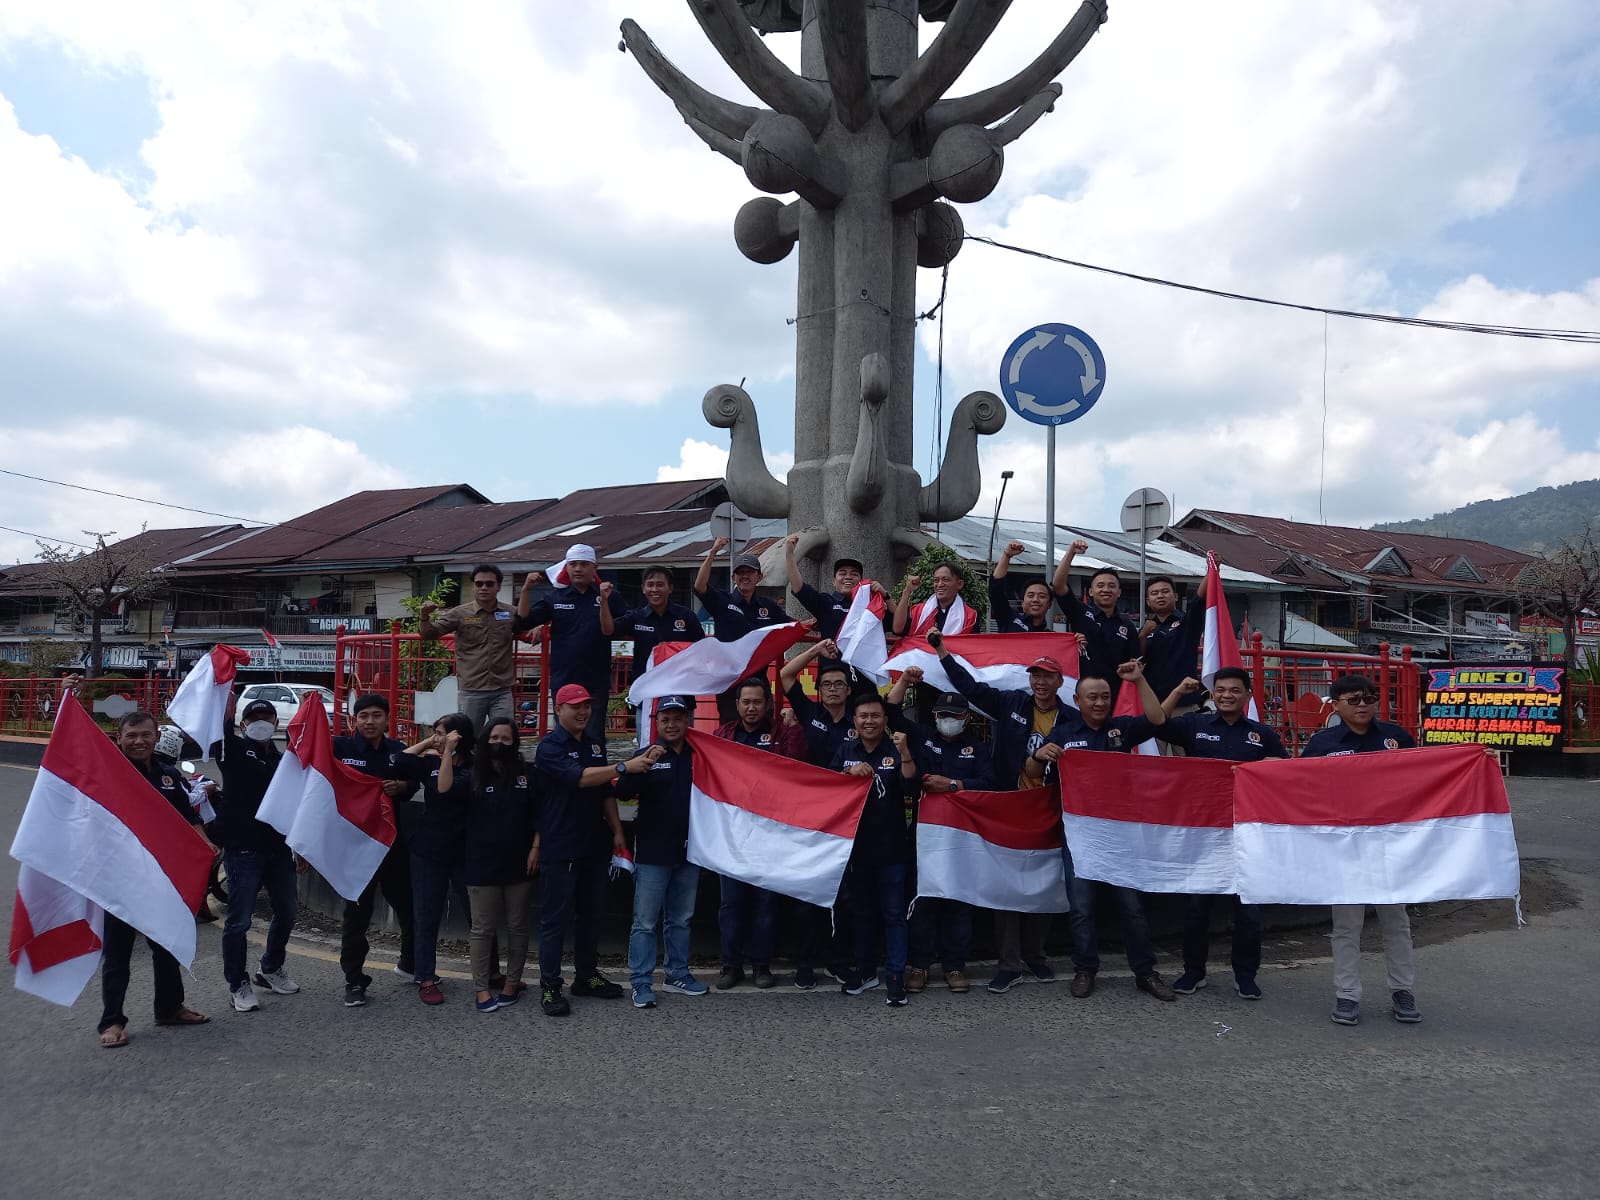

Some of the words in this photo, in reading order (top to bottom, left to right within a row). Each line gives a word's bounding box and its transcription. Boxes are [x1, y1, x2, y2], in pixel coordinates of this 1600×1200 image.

[320, 618, 349, 631] AGUNG
[350, 618, 370, 631] JAYA
[324, 651, 336, 660] JAY
[1459, 672, 1523, 684] INFO
[1425, 691, 1437, 704] DI
[1439, 691, 1467, 705] RJP
[1467, 692, 1563, 706] SUPERTECH
[1430, 705, 1466, 718] BELI
[1469, 705, 1518, 719] KUOTA
[1528, 706, 1558, 720] ACC
[1535, 720, 1562, 734] Dan
[1426, 730, 1475, 744] GARANSI
[1477, 731, 1515, 745] GANTI
[1517, 733, 1554, 747] BARU
